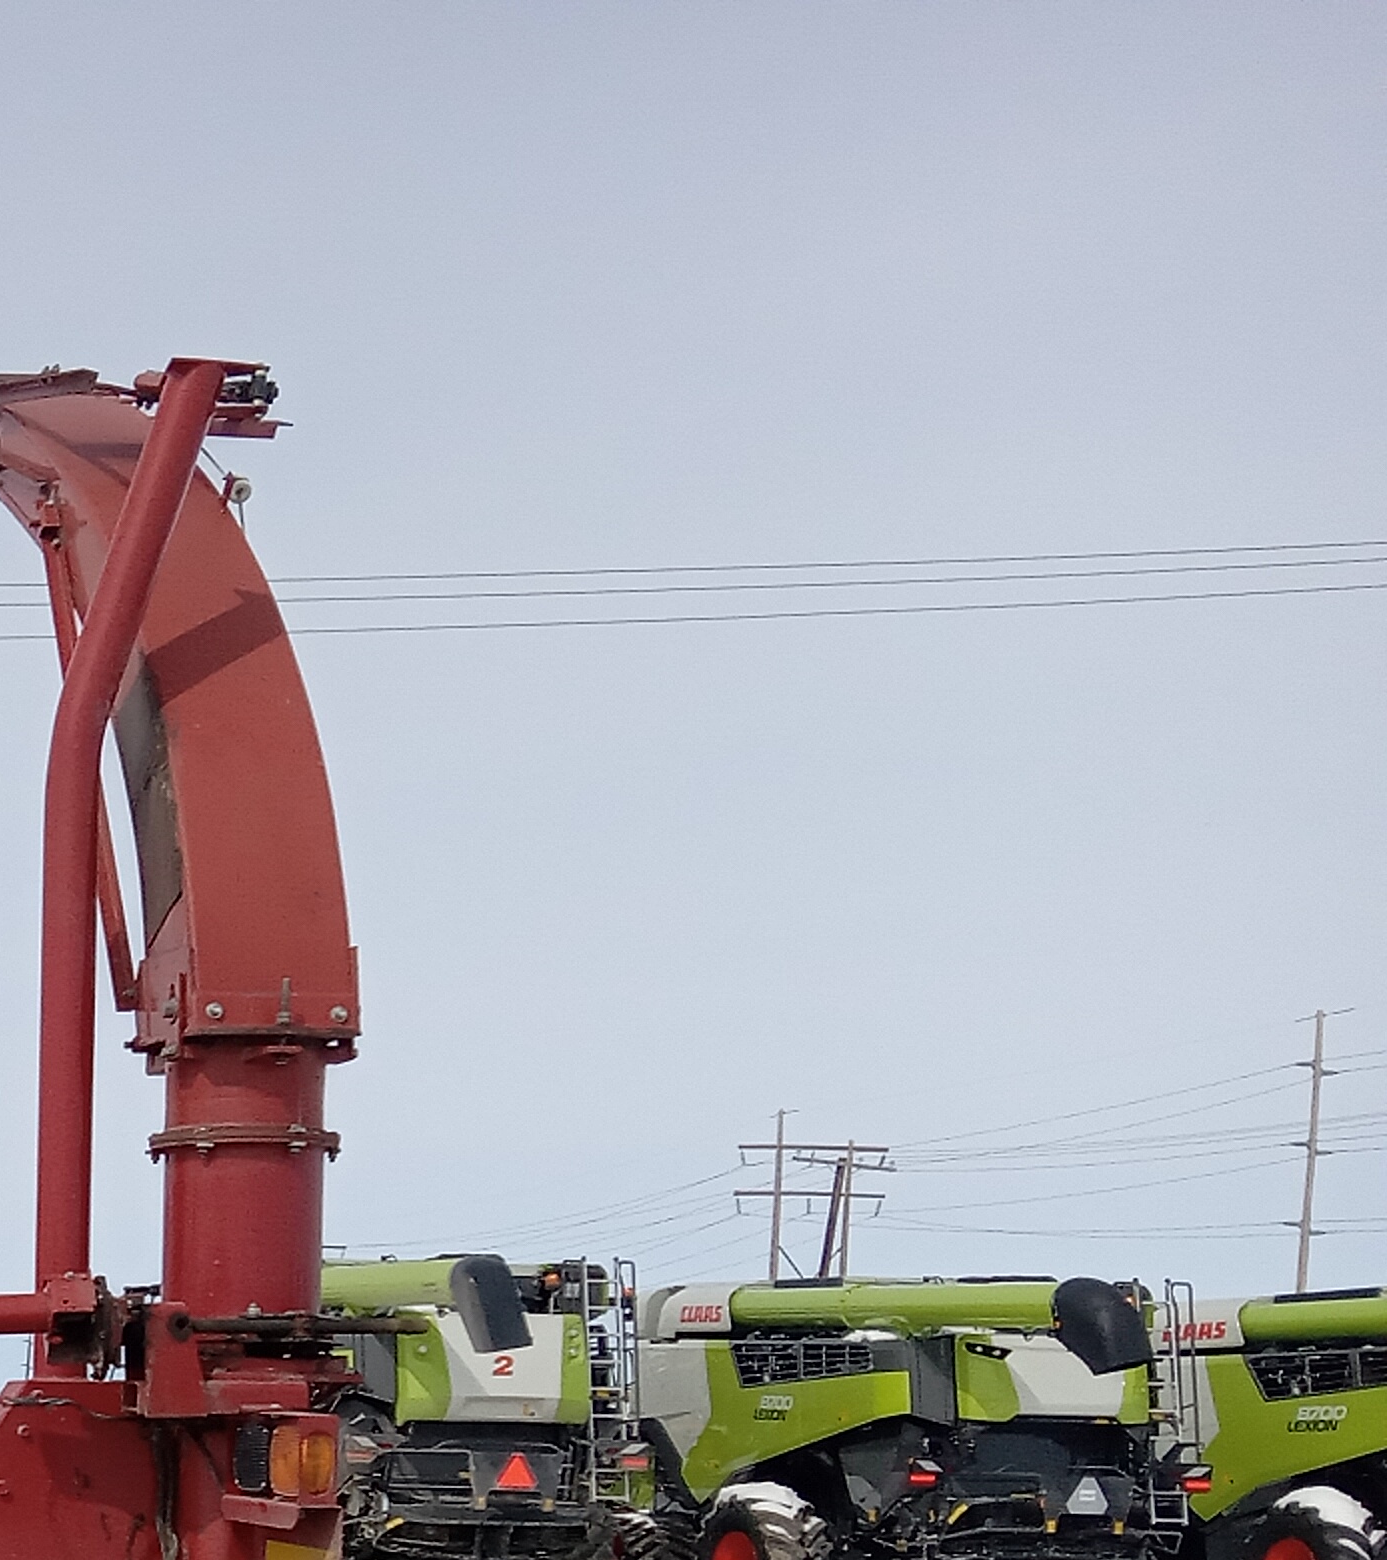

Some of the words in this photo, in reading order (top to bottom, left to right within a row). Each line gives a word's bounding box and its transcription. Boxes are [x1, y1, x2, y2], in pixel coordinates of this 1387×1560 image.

[680, 1305, 722, 1323] CLAAS
[492, 1355, 514, 1377] 2
[1296, 1405, 1347, 1420] 8700
[1287, 1420, 1339, 1432] LEXION
